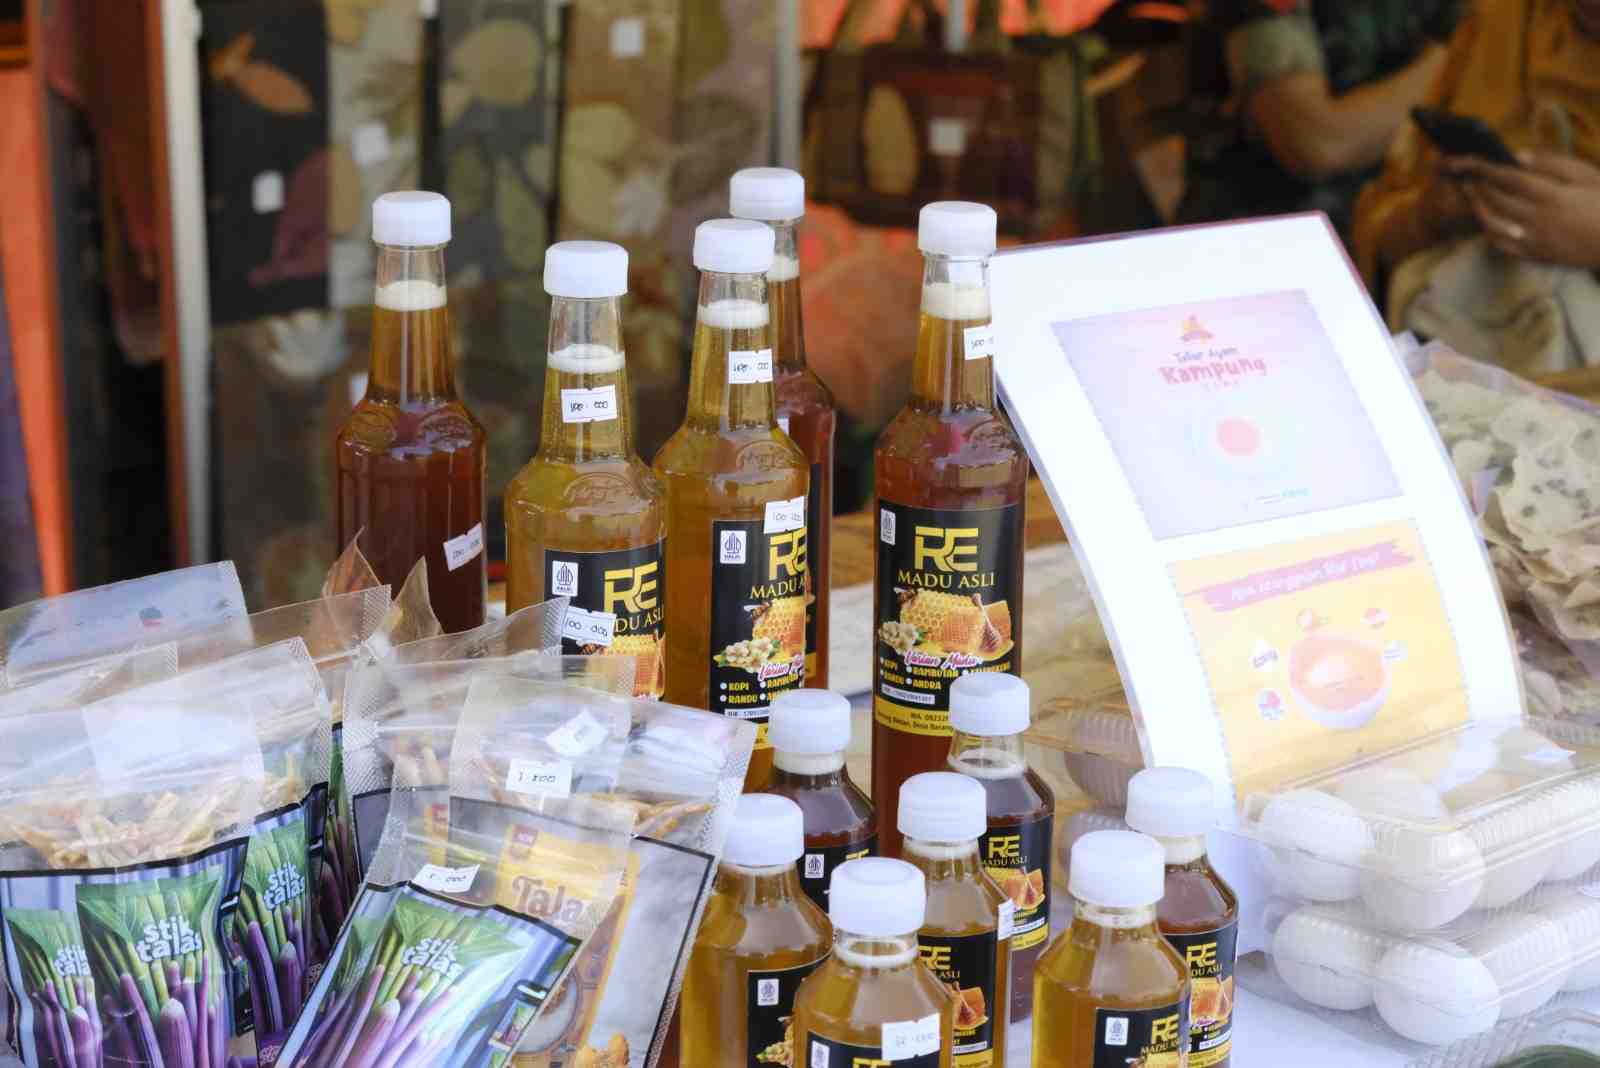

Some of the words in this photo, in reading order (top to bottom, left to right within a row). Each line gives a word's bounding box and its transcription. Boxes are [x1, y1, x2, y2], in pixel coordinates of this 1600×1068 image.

[914, 526, 979, 572] RE
[603, 560, 659, 613] RE
[750, 577, 798, 600] MADU
[898, 569, 952, 588] MADU
[958, 571, 996, 588] ASLI
[728, 682, 750, 691] KOPI
[728, 694, 758, 704] RANDU
[988, 835, 1020, 860] RE
[268, 863, 300, 886] stik
[143, 915, 194, 943] stik
[415, 937, 457, 962] stik
[1186, 942, 1217, 968] RE
[401, 946, 464, 979] talas
[1151, 1013, 1179, 1046] RE
